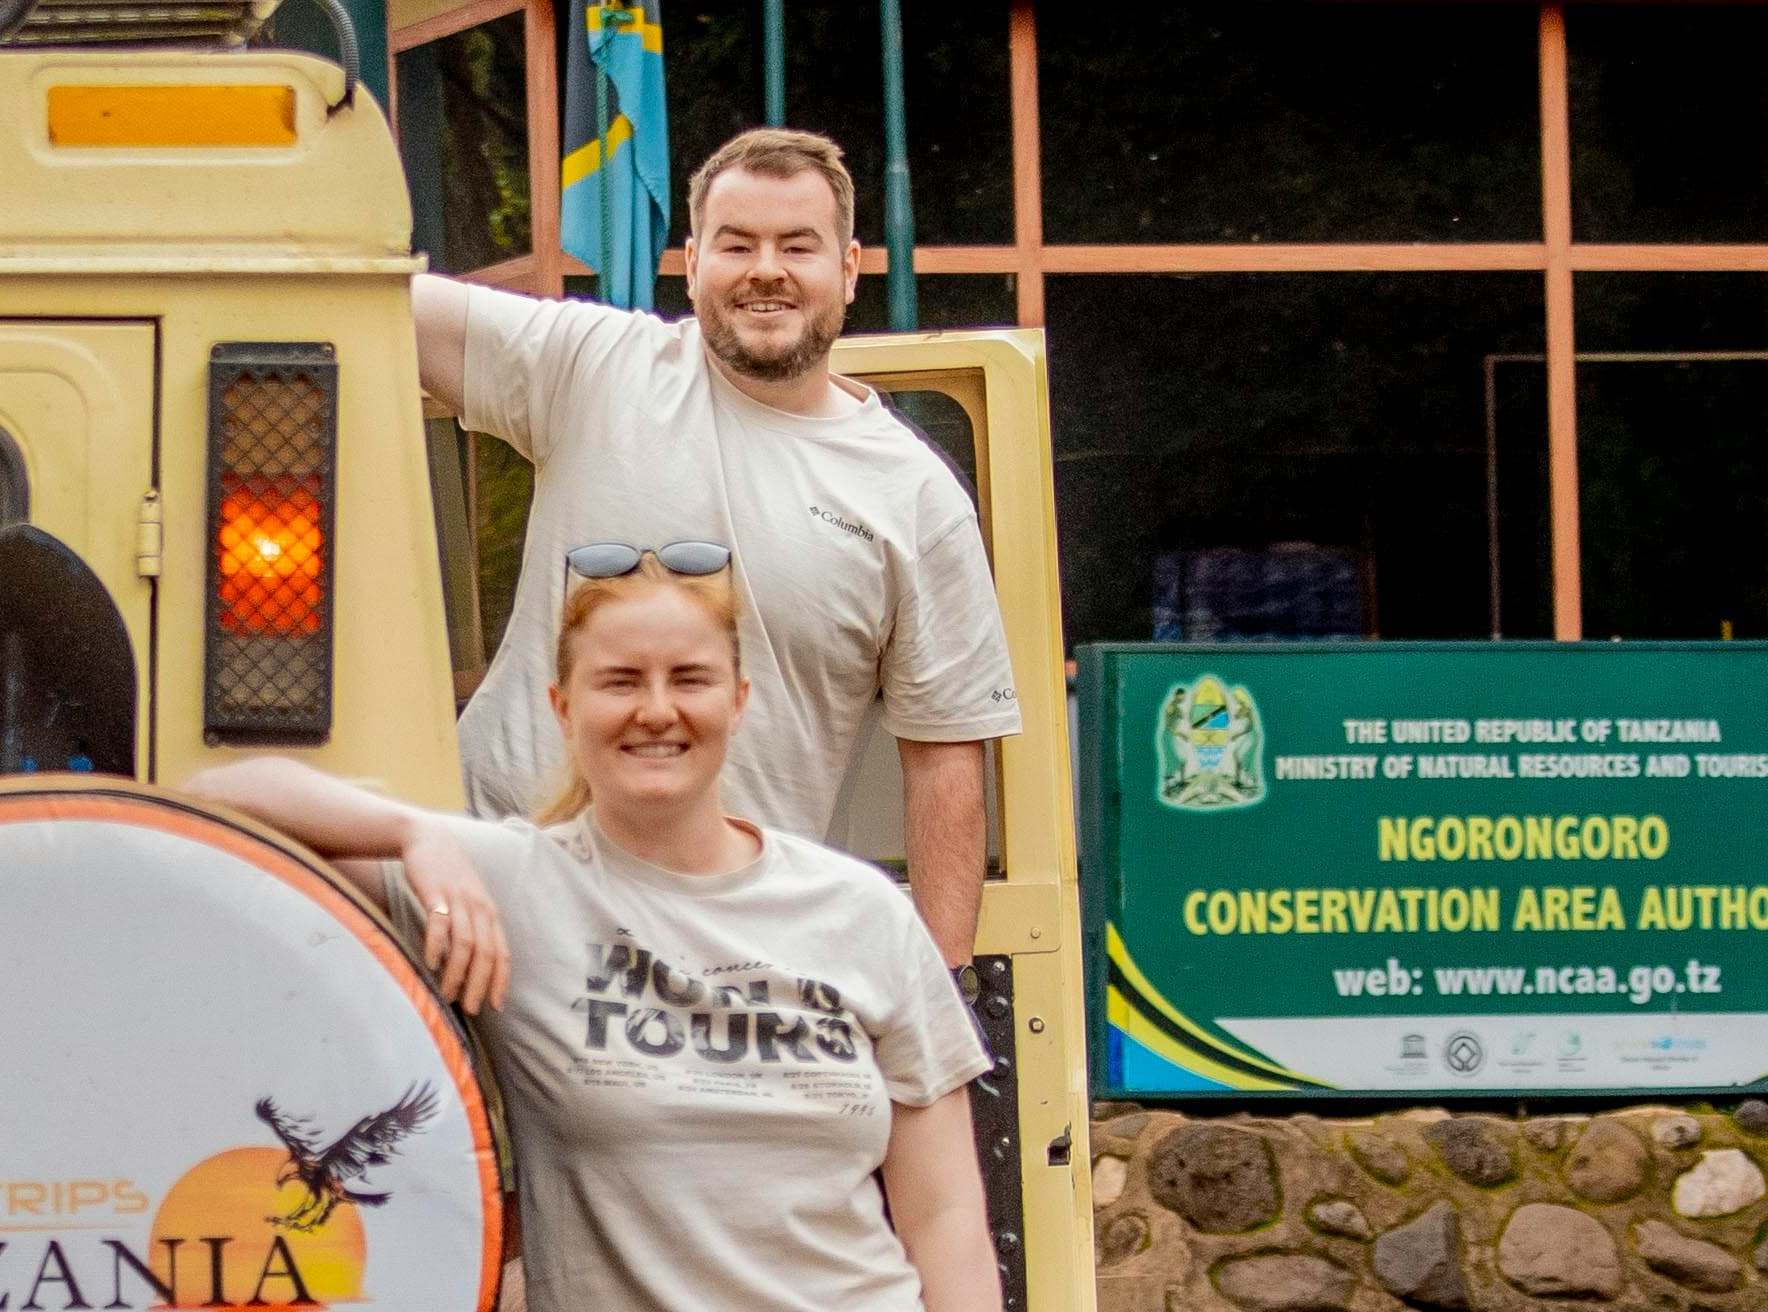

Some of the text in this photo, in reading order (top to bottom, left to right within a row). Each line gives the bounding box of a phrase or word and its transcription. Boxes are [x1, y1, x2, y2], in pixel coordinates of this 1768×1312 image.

[821, 511, 875, 543] Columbia
[1343, 719, 1722, 744] THE UNITED REPUBLIC OF TANZANIA
[1275, 753, 1768, 780] MINISTRY OF NATURAL RESOURCES AND TOURIS
[1378, 815, 1670, 861] NGORONGORO
[1184, 885, 1768, 935] CONSERVATION AREA AUTHO
[1334, 958, 1722, 1005] web: www.ncaa.go.tz
[582, 998, 860, 1065] TOURS
